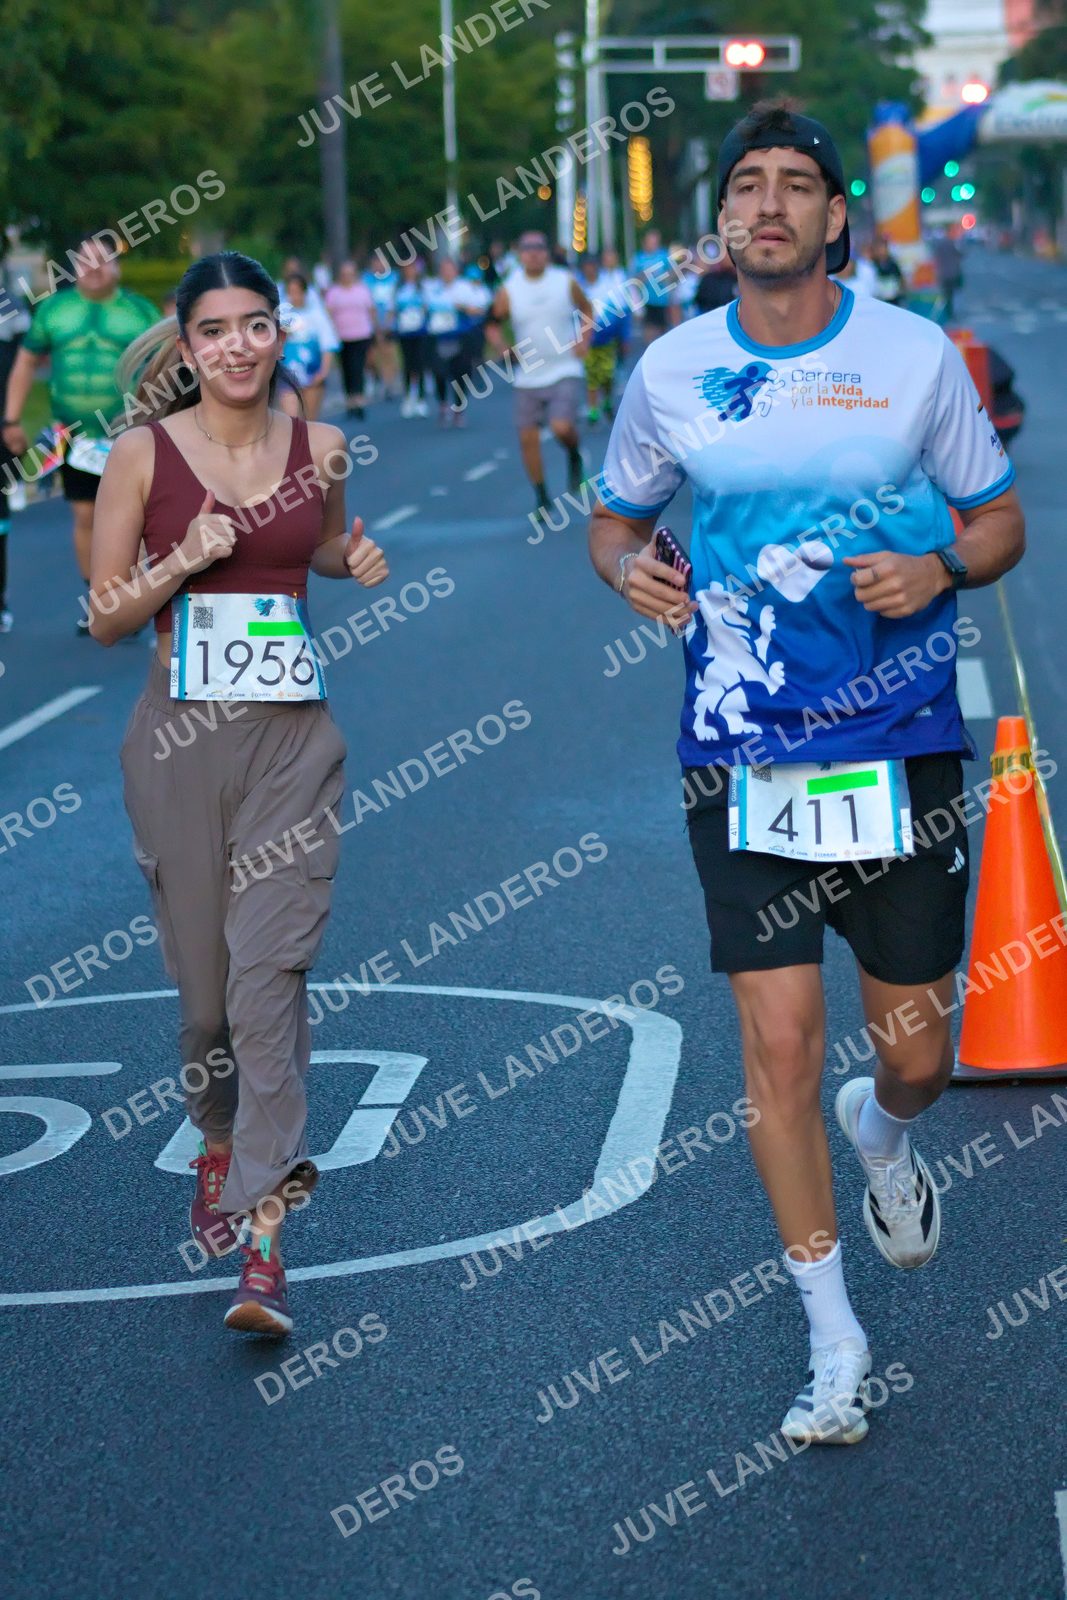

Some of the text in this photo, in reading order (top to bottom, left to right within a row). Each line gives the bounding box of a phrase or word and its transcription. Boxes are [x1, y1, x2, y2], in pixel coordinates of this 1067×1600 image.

[791, 369, 861, 384] Carrera
[818, 383, 829, 394] la
[832, 384, 863, 396] Vida
[817, 395, 889, 409] Integridad
[196, 639, 315, 686] 1956
[767, 794, 859, 845] 411
